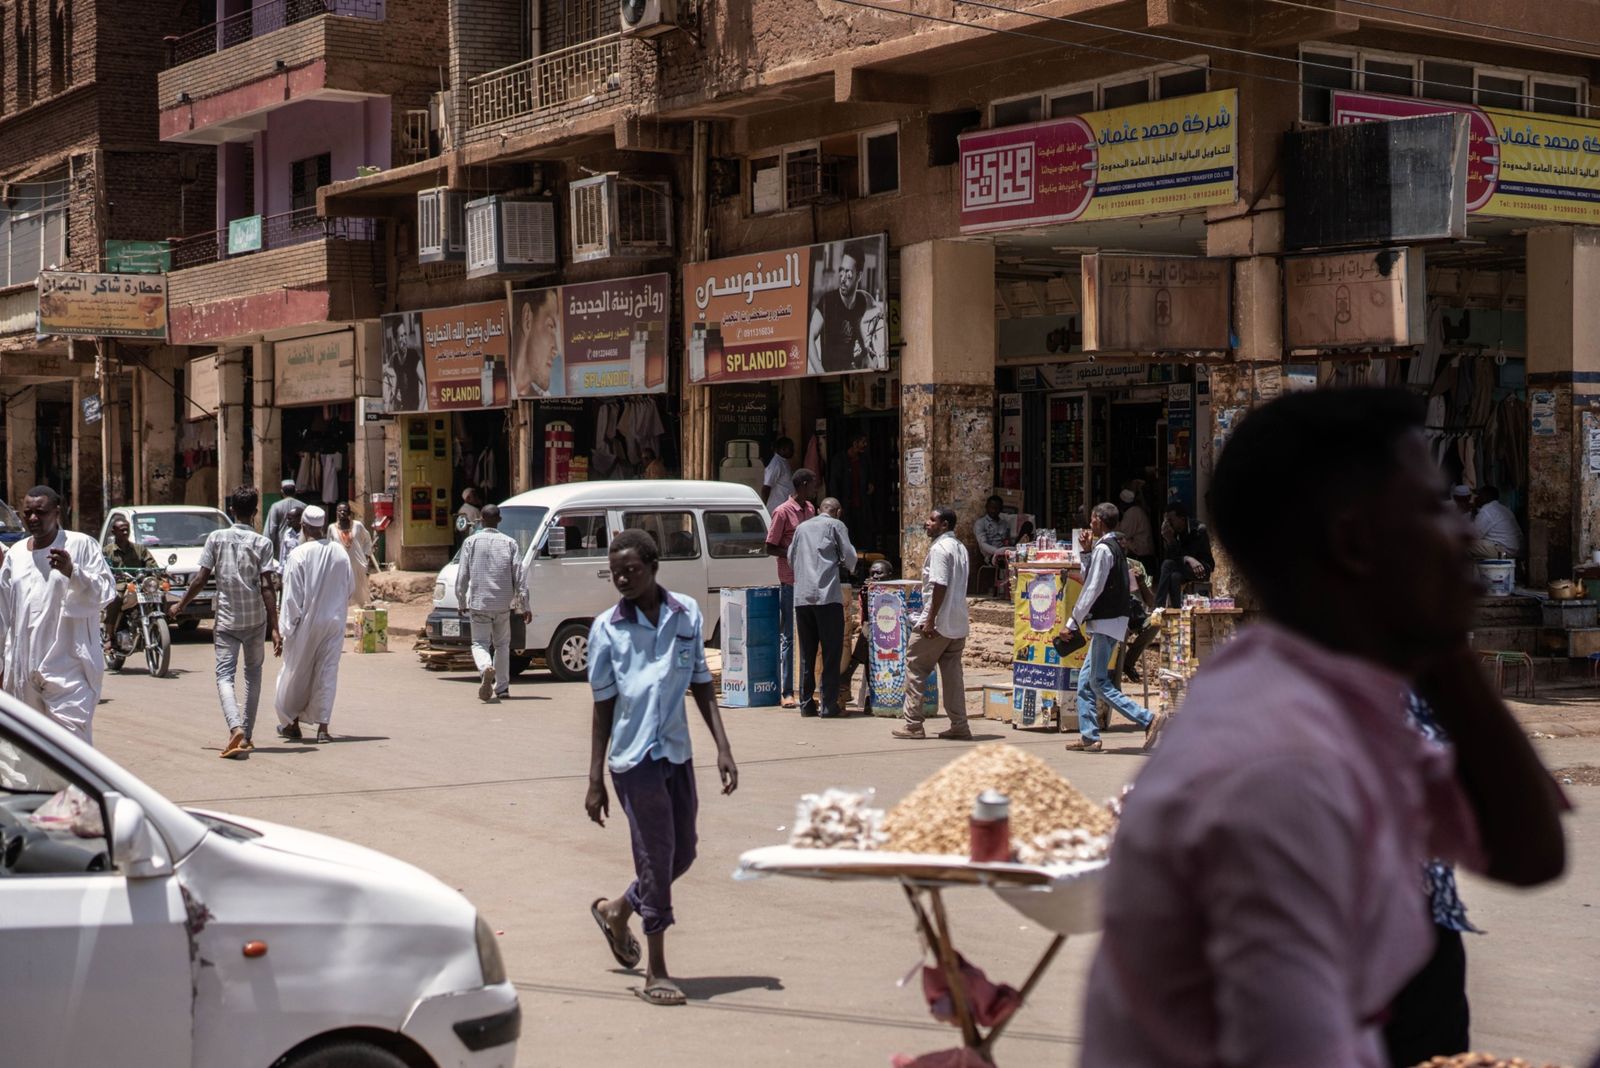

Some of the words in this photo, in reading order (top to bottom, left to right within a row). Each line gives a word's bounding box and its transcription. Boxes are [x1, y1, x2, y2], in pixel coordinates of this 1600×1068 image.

[1182, 105, 1230, 133] شركة
[1098, 119, 1138, 145] عثمان
[1142, 121, 1178, 138] محمد
[1500, 125, 1541, 146] عثمان
[1202, 144, 1231, 158] للتحاويل
[1544, 134, 1579, 151] محمد
[1130, 156, 1150, 167] العامة
[1151, 152, 1177, 164] الداخلية
[1180, 148, 1200, 161] المالية
[1100, 159, 1129, 171] المحدودة
[1502, 160, 1532, 171] المحدودة
[1533, 163, 1552, 173] العامة
[1553, 165, 1578, 175] الداخلية
[1580, 168, 1599, 178] المالية
[1191, 173, 1213, 181] TRANSFER
[1539, 187, 1558, 195] GENERAL
[91, 275, 121, 295] شاكر
[124, 279, 163, 296] عطارة
[695, 252, 801, 320] السنوسي
[569, 289, 610, 320] الجديدة
[612, 289, 634, 316] زينة
[634, 284, 664, 318] روائح
[425, 322, 452, 348] التجارية
[452, 321, 465, 340] الله
[287, 342, 315, 365] للأقمشة
[317, 341, 340, 366] القدس
[726, 349, 787, 372] SPLANDID
[1076, 364, 1104, 380] للعطور
[1105, 362, 1145, 378] السنوسي
[583, 370, 630, 388] SPLANDID
[441, 386, 481, 402] SPLANDID
